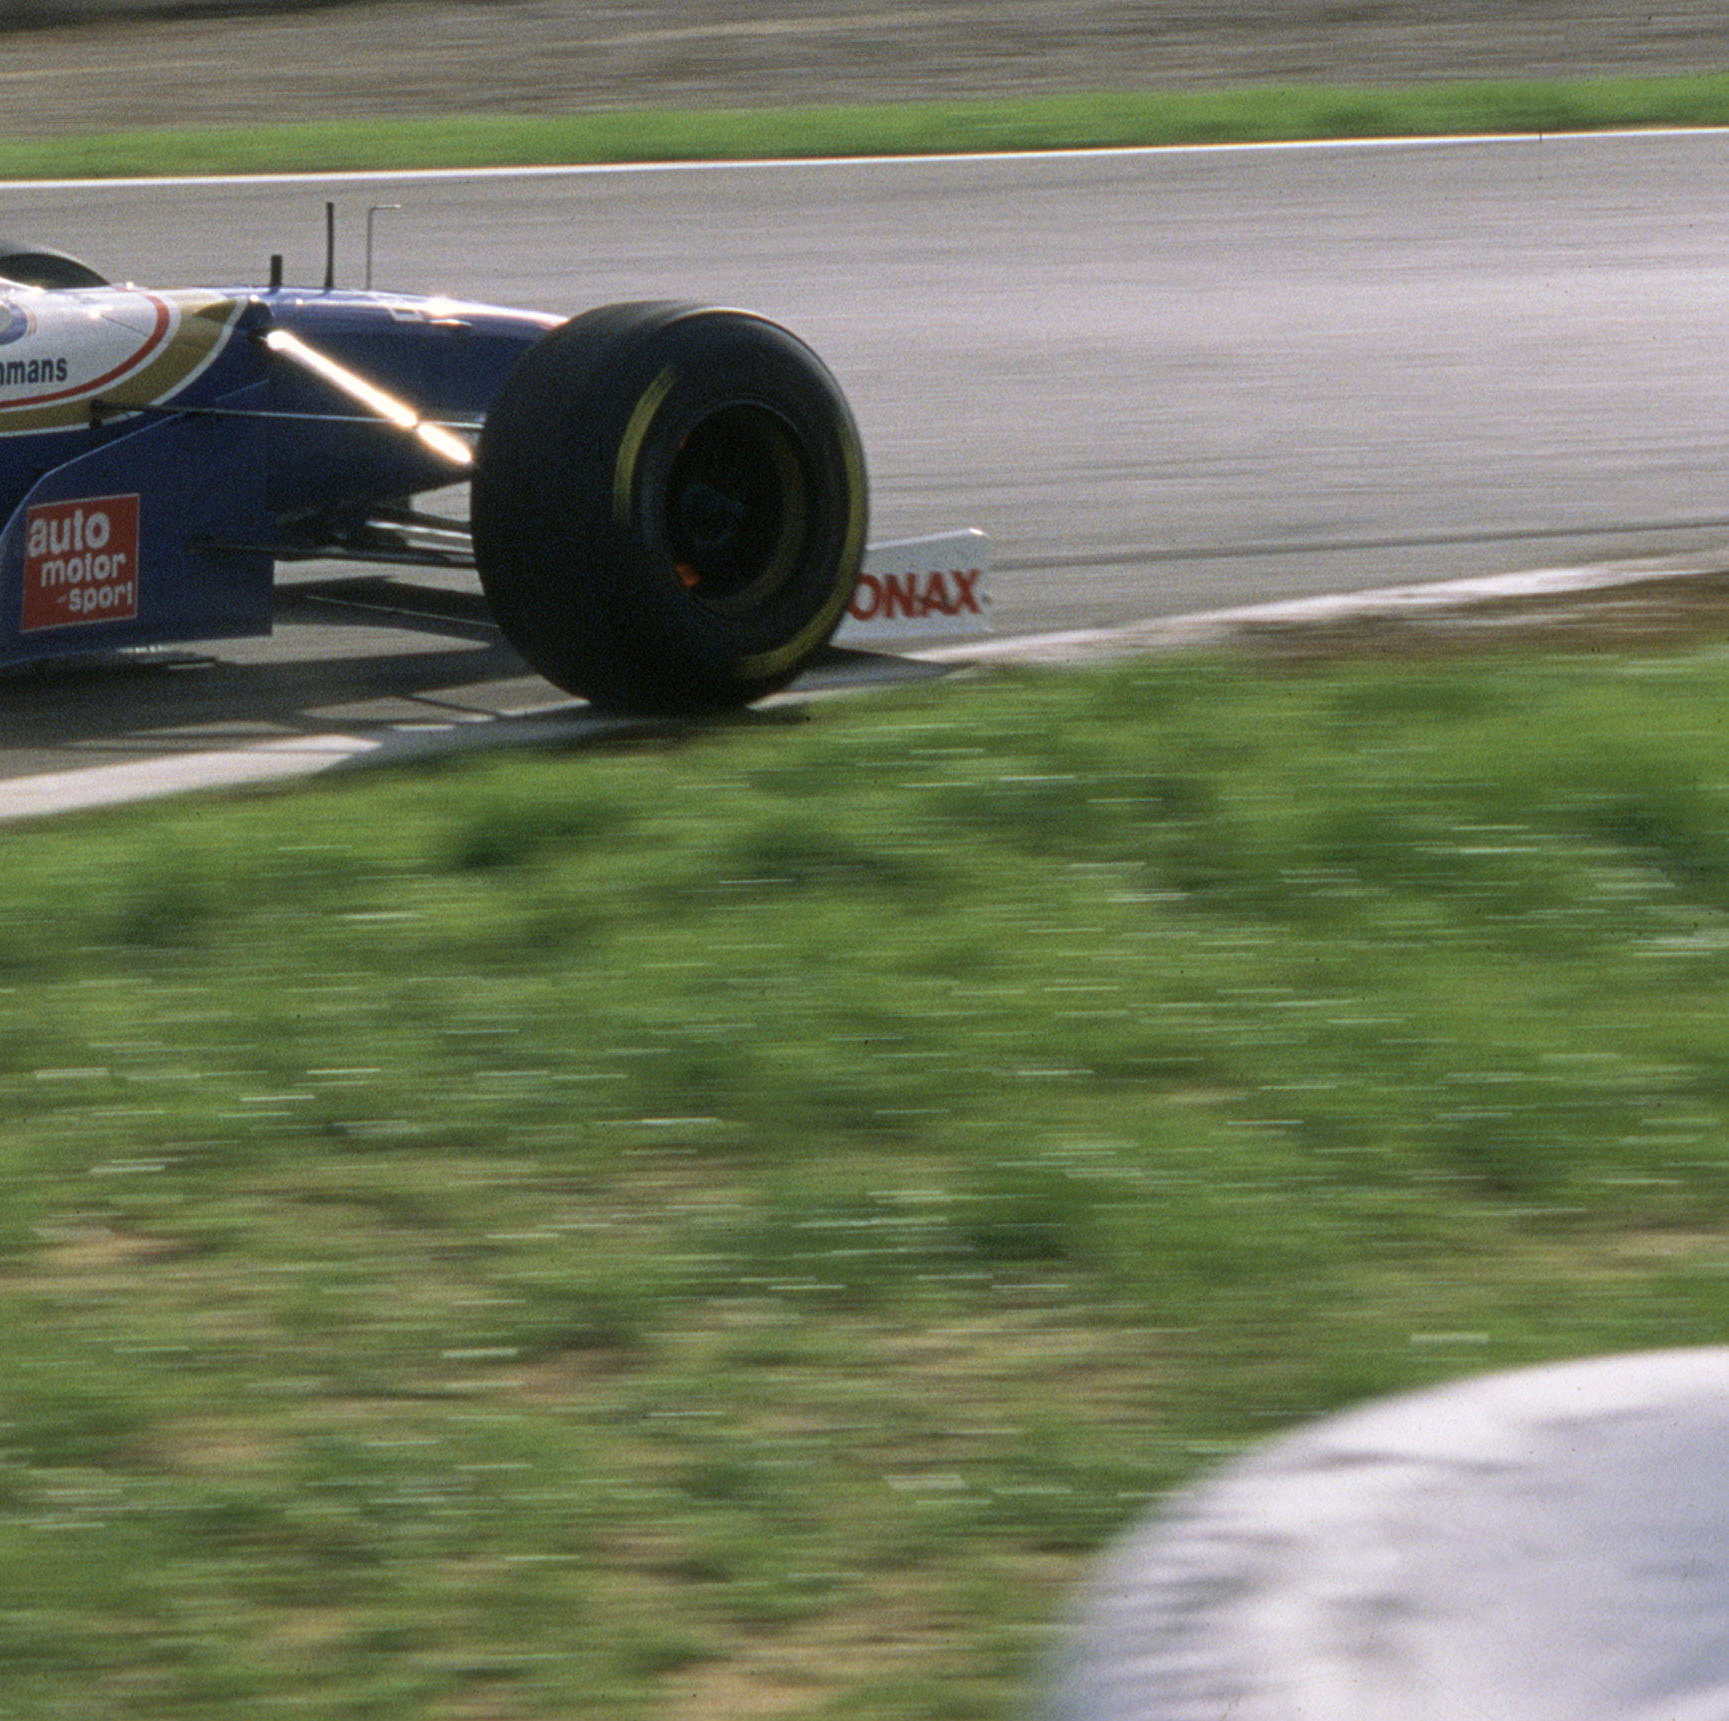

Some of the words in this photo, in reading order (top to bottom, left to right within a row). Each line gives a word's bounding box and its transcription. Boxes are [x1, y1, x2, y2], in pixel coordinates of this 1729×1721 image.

[28, 509, 110, 558] auto
[41, 552, 126, 588] motor
[68, 581, 134, 614] sport
